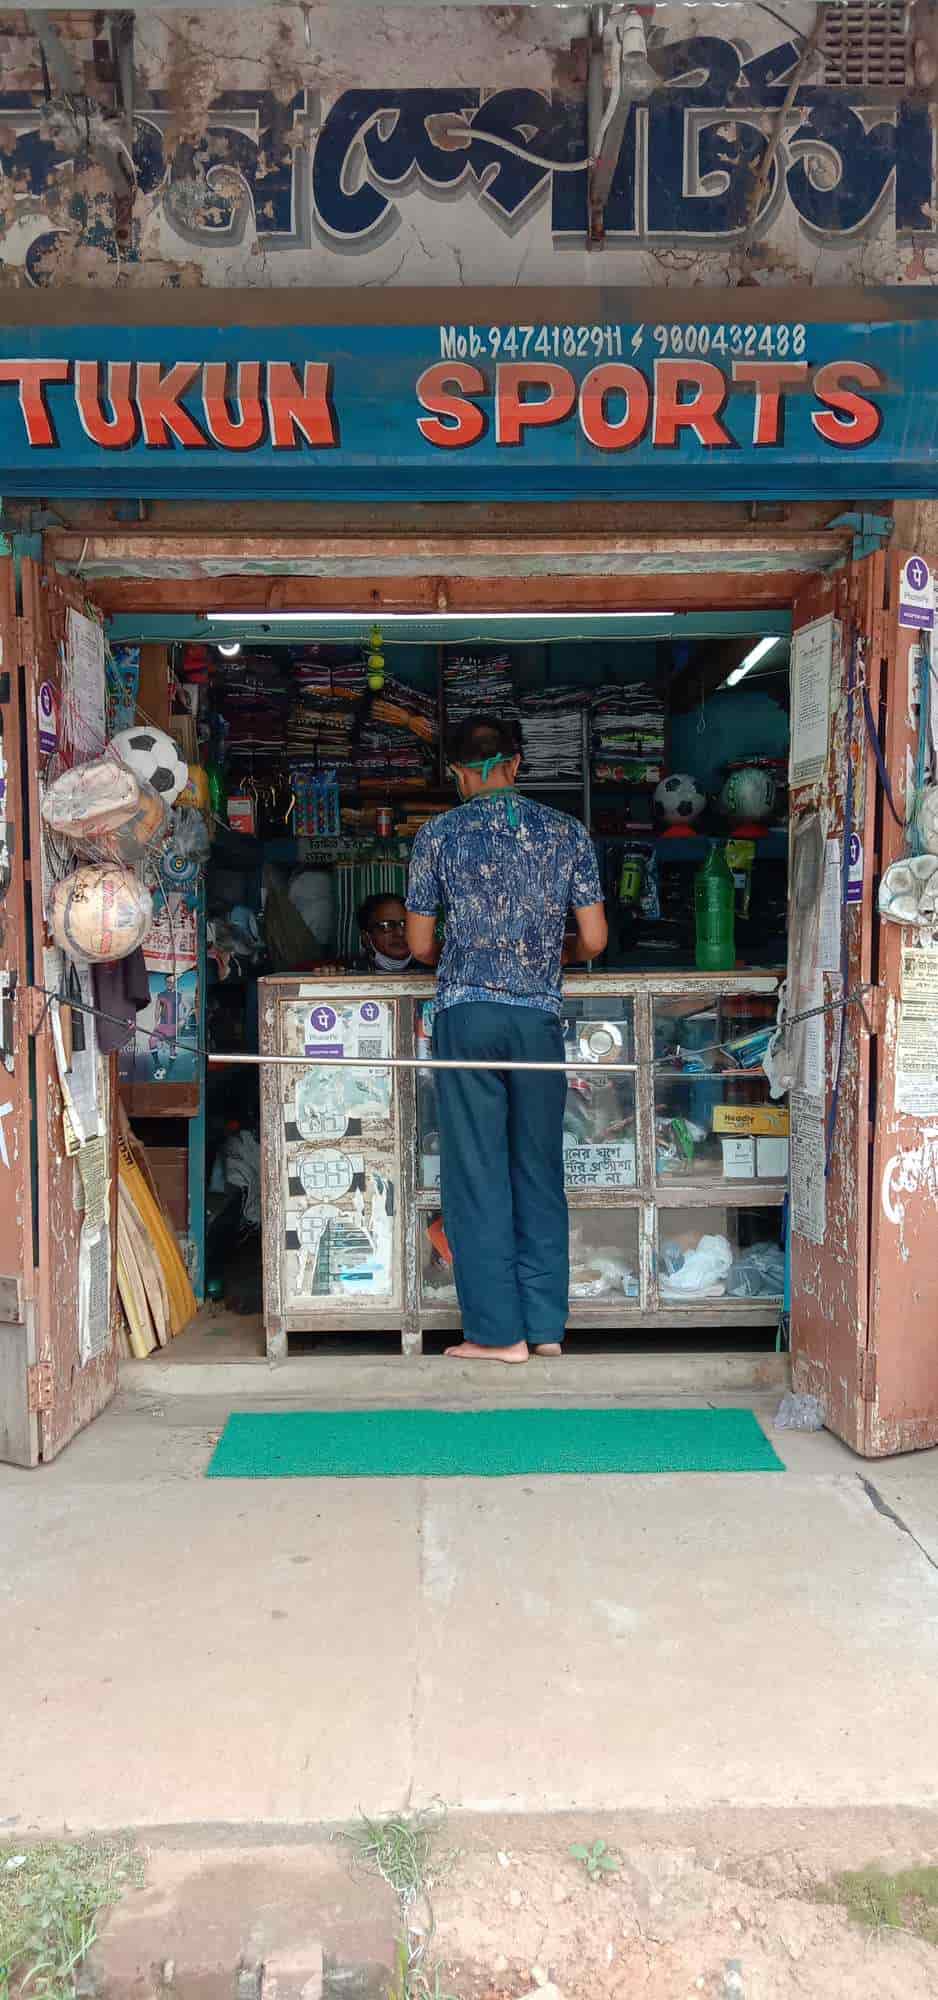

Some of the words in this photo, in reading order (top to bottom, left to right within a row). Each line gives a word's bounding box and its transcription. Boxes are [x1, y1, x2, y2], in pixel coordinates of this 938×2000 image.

[653, 323, 806, 358] 9800432488
[0, 358, 337, 450] TUKUN
[415, 358, 882, 450] SPORTS
